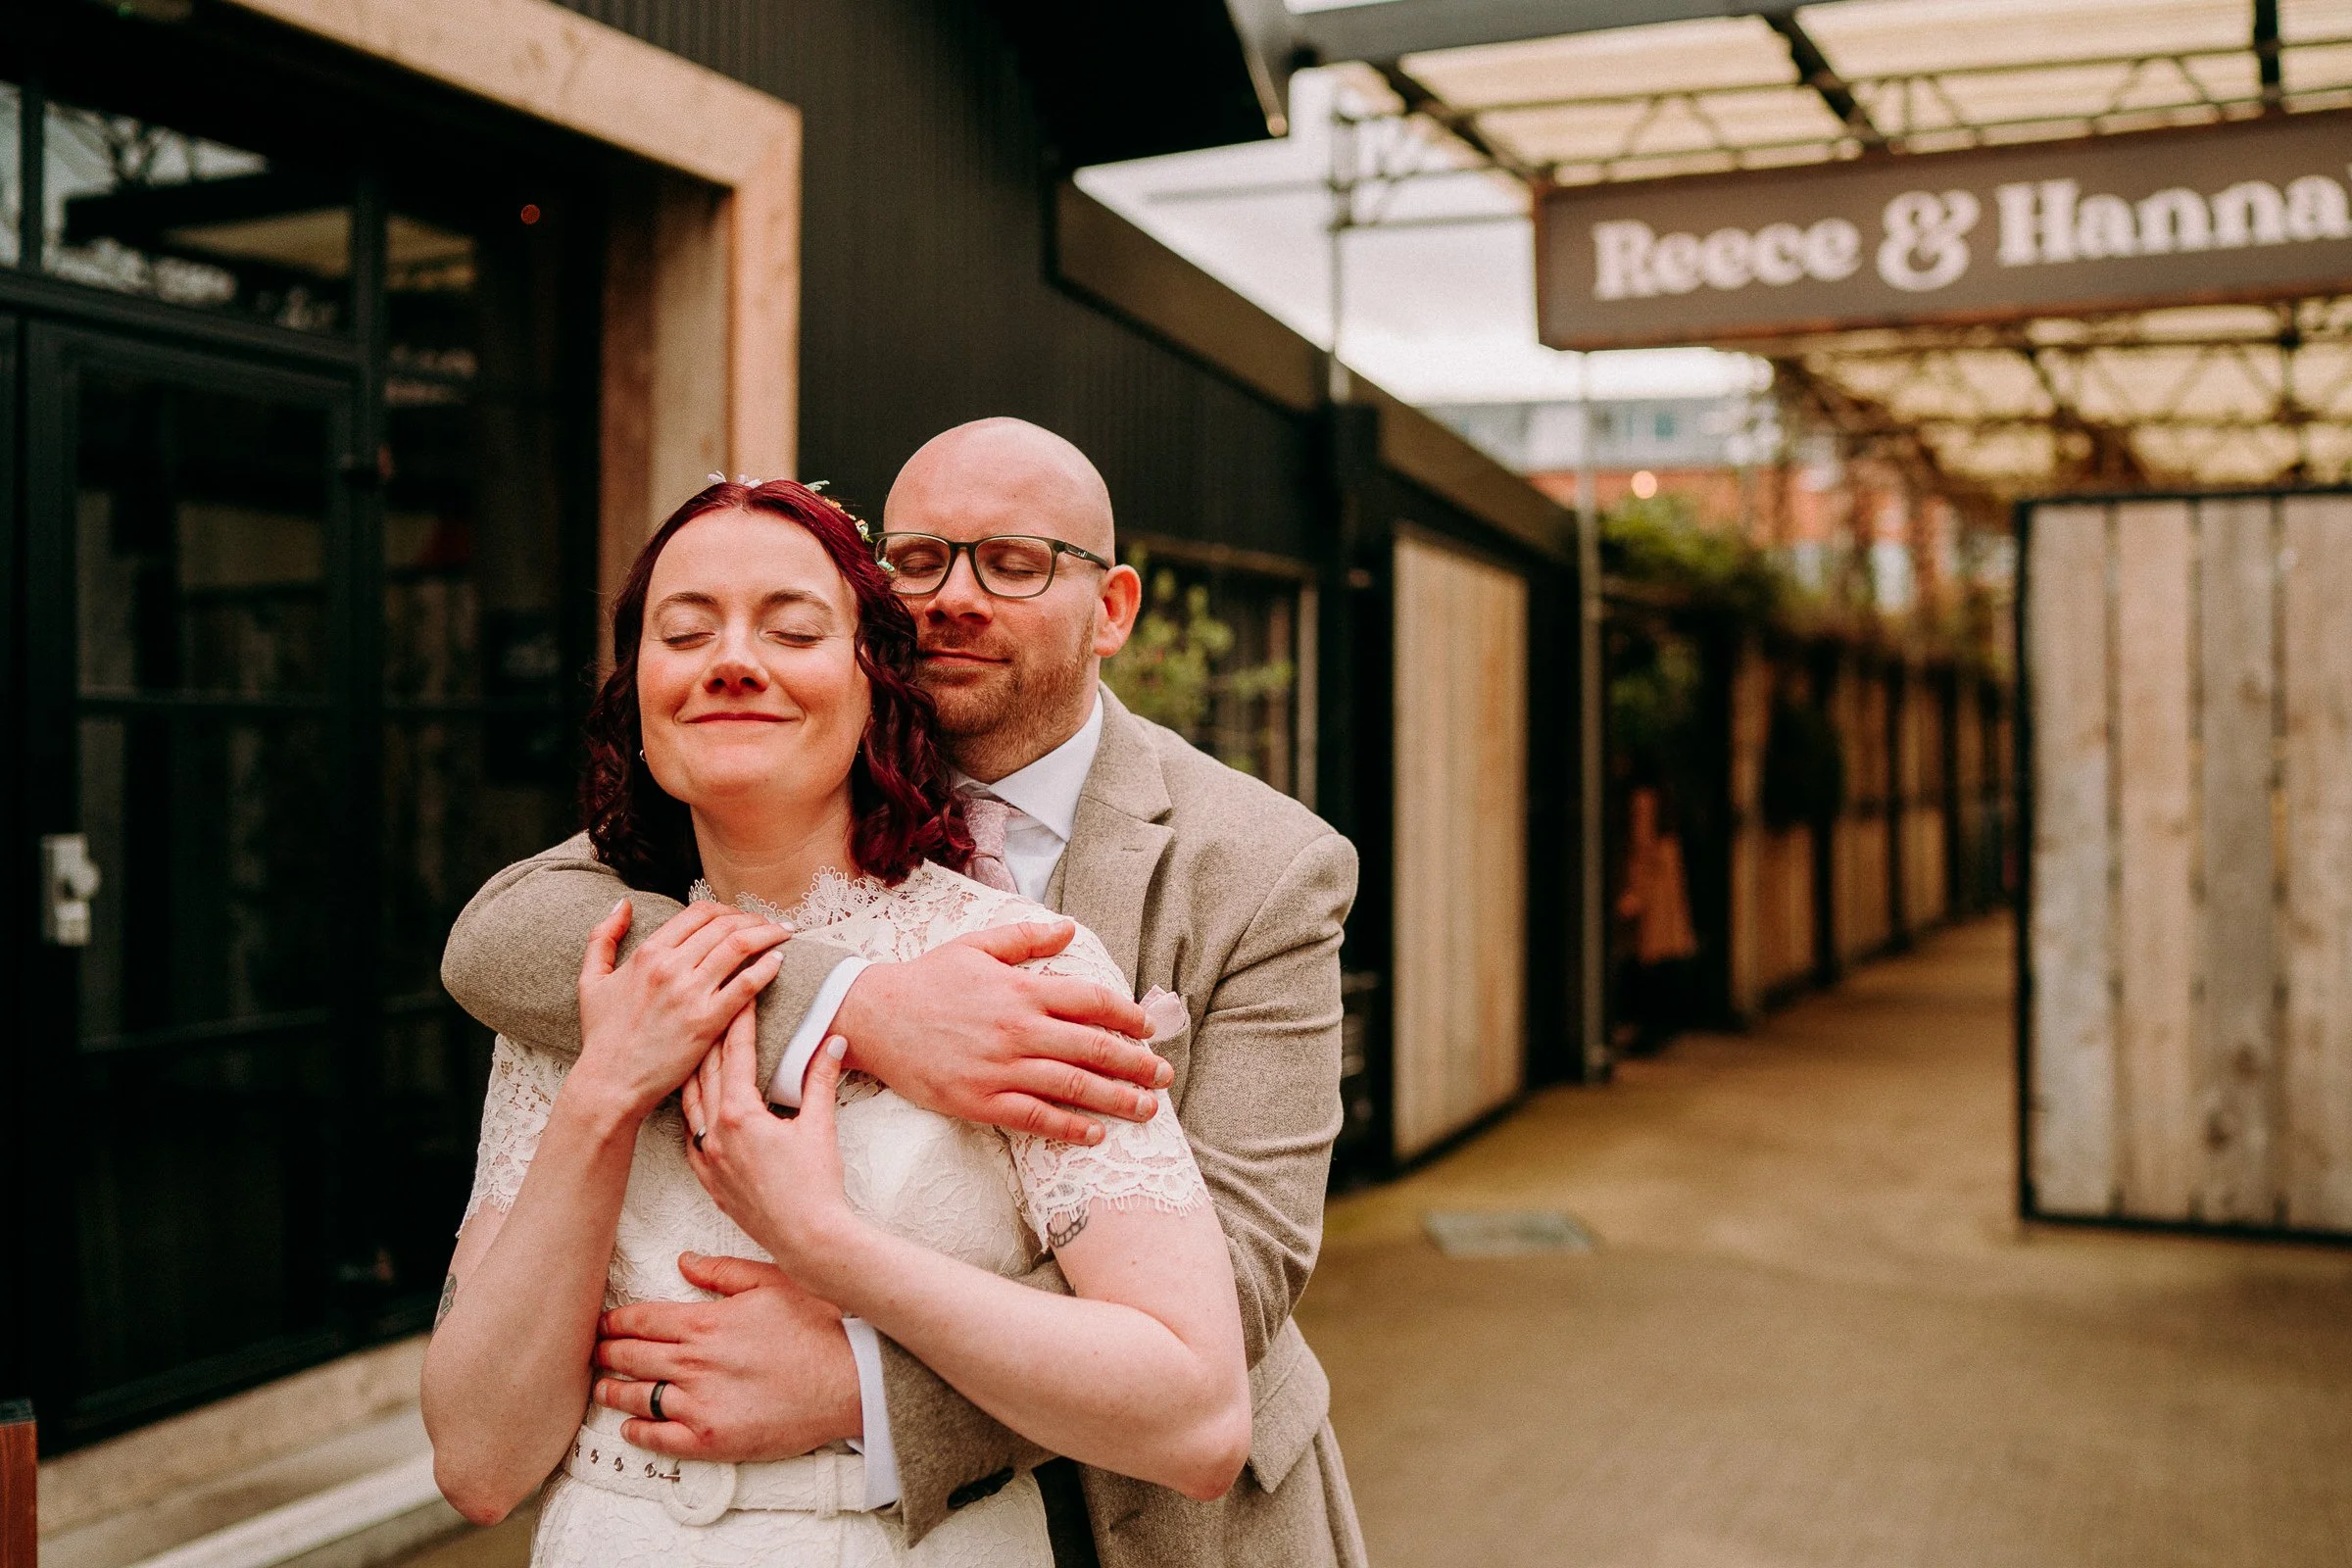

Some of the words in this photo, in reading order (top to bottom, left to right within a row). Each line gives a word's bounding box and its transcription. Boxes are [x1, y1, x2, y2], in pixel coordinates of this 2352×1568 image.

[1592, 218, 1861, 301] Reece
[1874, 190, 1981, 292] &
[1996, 165, 2352, 268] Hanna
